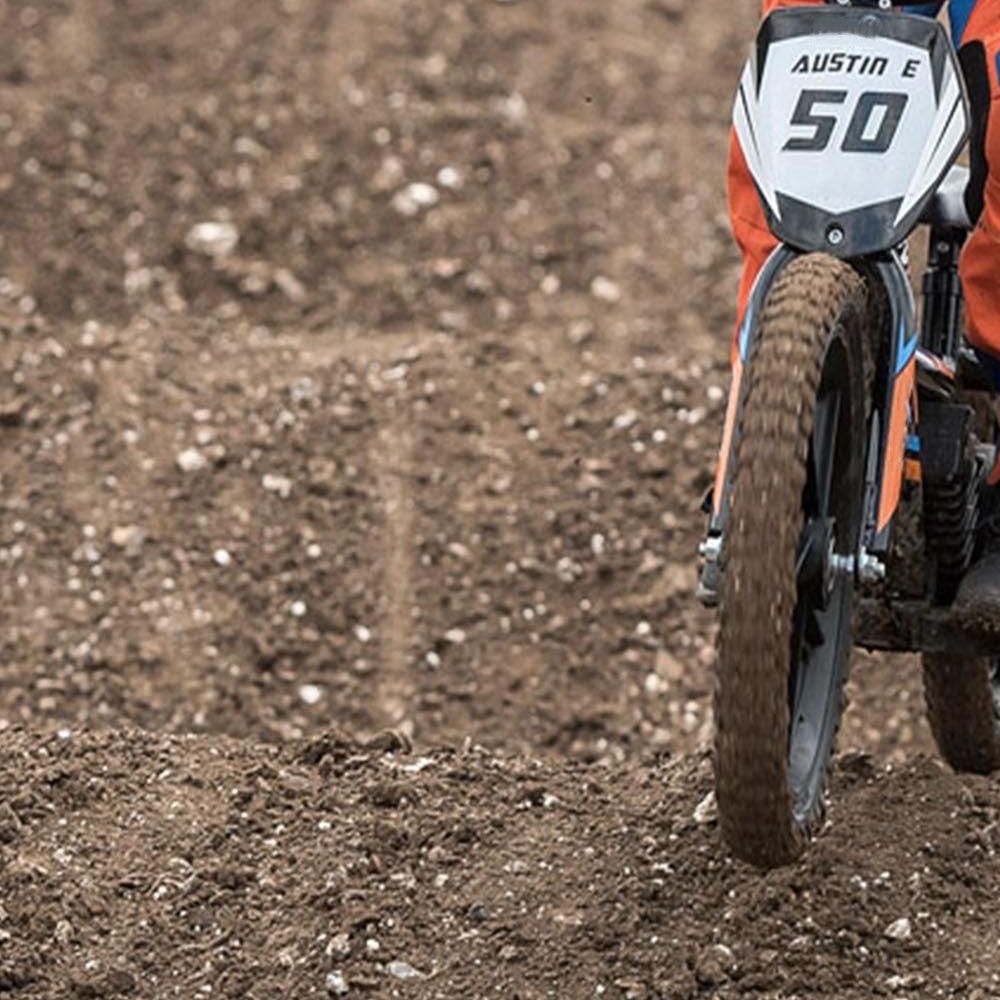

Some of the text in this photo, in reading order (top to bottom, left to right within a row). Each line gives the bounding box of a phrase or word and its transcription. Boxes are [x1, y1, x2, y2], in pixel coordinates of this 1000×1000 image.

[791, 53, 921, 78] AUSTIN E
[781, 89, 909, 154] 50
